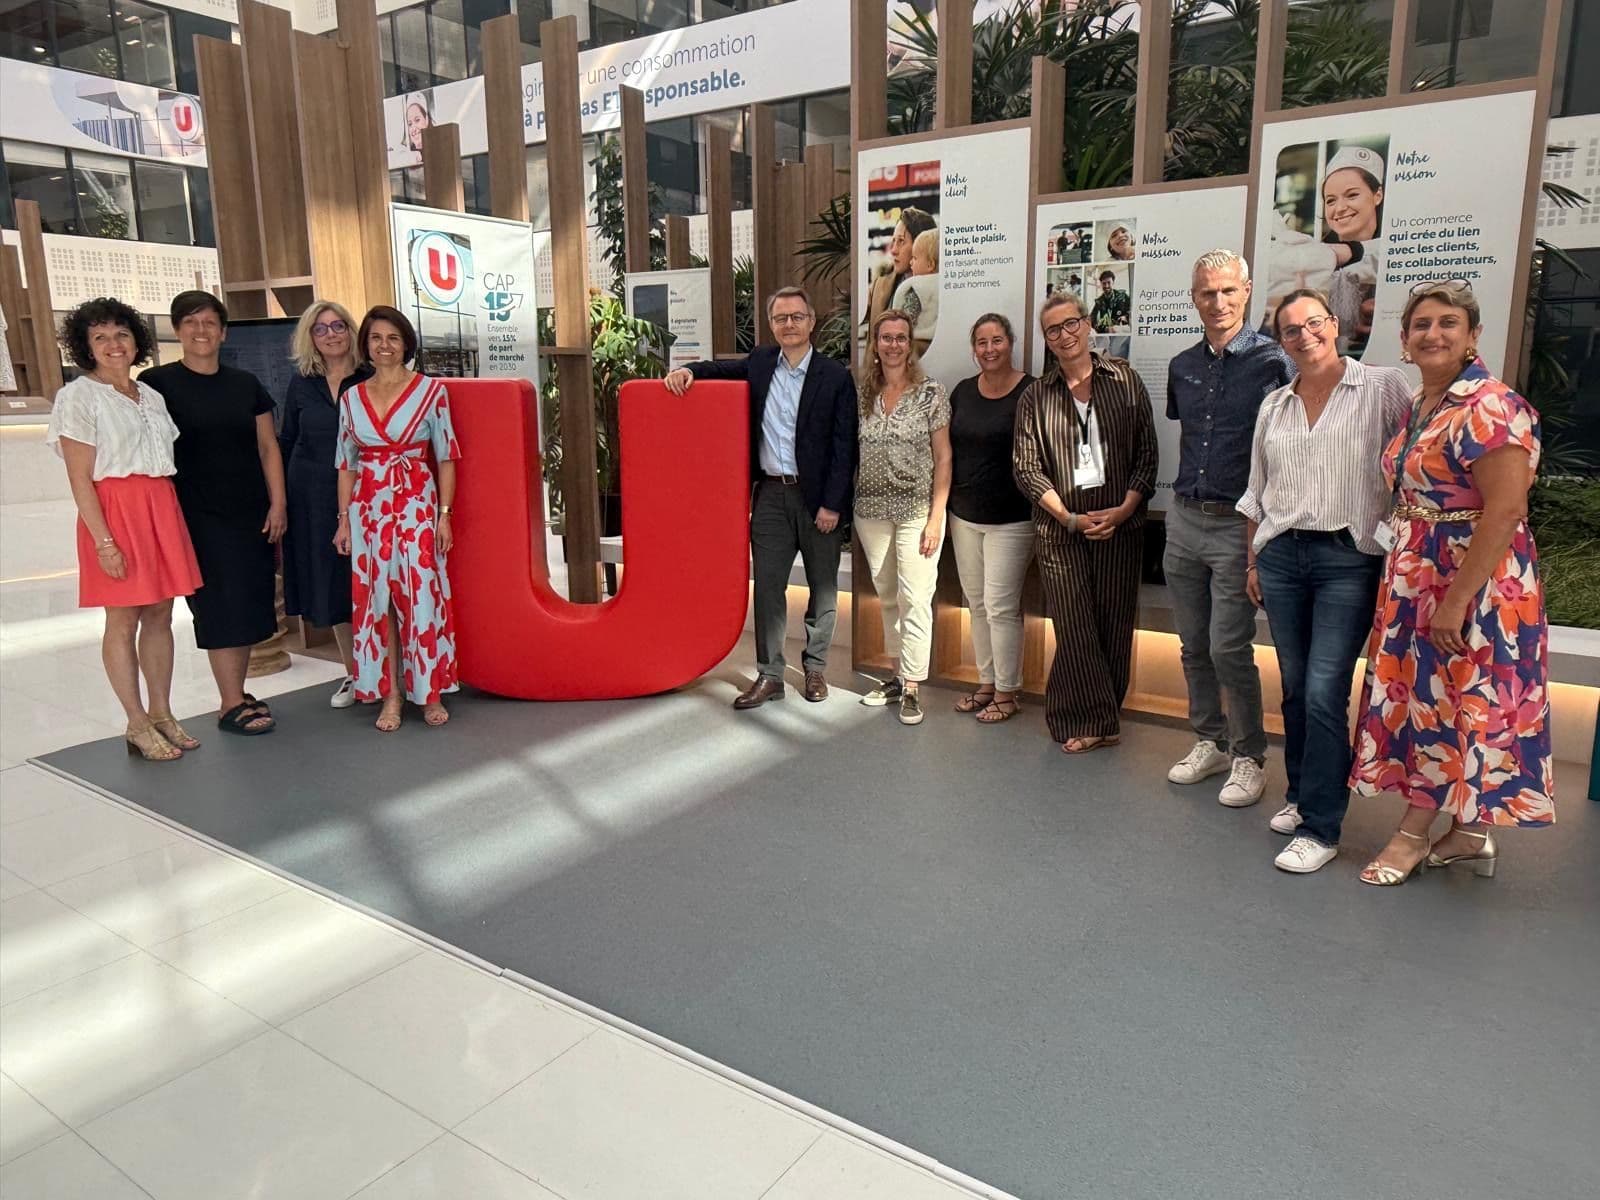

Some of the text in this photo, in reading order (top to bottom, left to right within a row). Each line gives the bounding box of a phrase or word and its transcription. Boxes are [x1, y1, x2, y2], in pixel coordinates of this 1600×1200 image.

[587, 64, 617, 85] une
[622, 33, 756, 77] consommation
[524, 109, 532, 127] à
[645, 69, 745, 106] sponsable.
[175, 106, 193, 132] U
[1396, 150, 1431, 166] Notre
[945, 172, 968, 185] Notre
[1394, 170, 1437, 182] vision
[945, 184, 967, 198] client
[1391, 214, 1473, 228] Un commerce
[945, 226, 954, 234] Je
[955, 226, 974, 234] veux
[975, 223, 993, 232] tout
[1389, 227, 1480, 243] qui crée du lien
[945, 232, 1007, 247] le prix, le plaisir,
[1142, 232, 1169, 246] Notre
[945, 248, 952, 256] la
[1141, 248, 1182, 259] mission
[1388, 241, 1480, 255] avec les clients,
[955, 258, 979, 267] faisant
[980, 256, 1014, 266] attention
[1387, 256, 1497, 269] les collaborateurs,
[428, 247, 458, 291] U
[950, 270, 956, 278] la
[958, 269, 985, 279] planète
[483, 272, 515, 292] CAP
[1386, 270, 1481, 284] les producteurs.
[953, 281, 966, 289] aux
[1139, 289, 1158, 301] Agir
[1161, 289, 1184, 300] pour
[484, 291, 511, 321] 15
[1139, 302, 1194, 311] consomma
[1138, 313, 1188, 325] à prix bas
[1138, 326, 1151, 336] ET
[502, 334, 517, 342] 15%
[488, 344, 513, 353] de part
[489, 354, 525, 362] de marché
[499, 363, 517, 371] 2030
[449, 378, 750, 703] U
